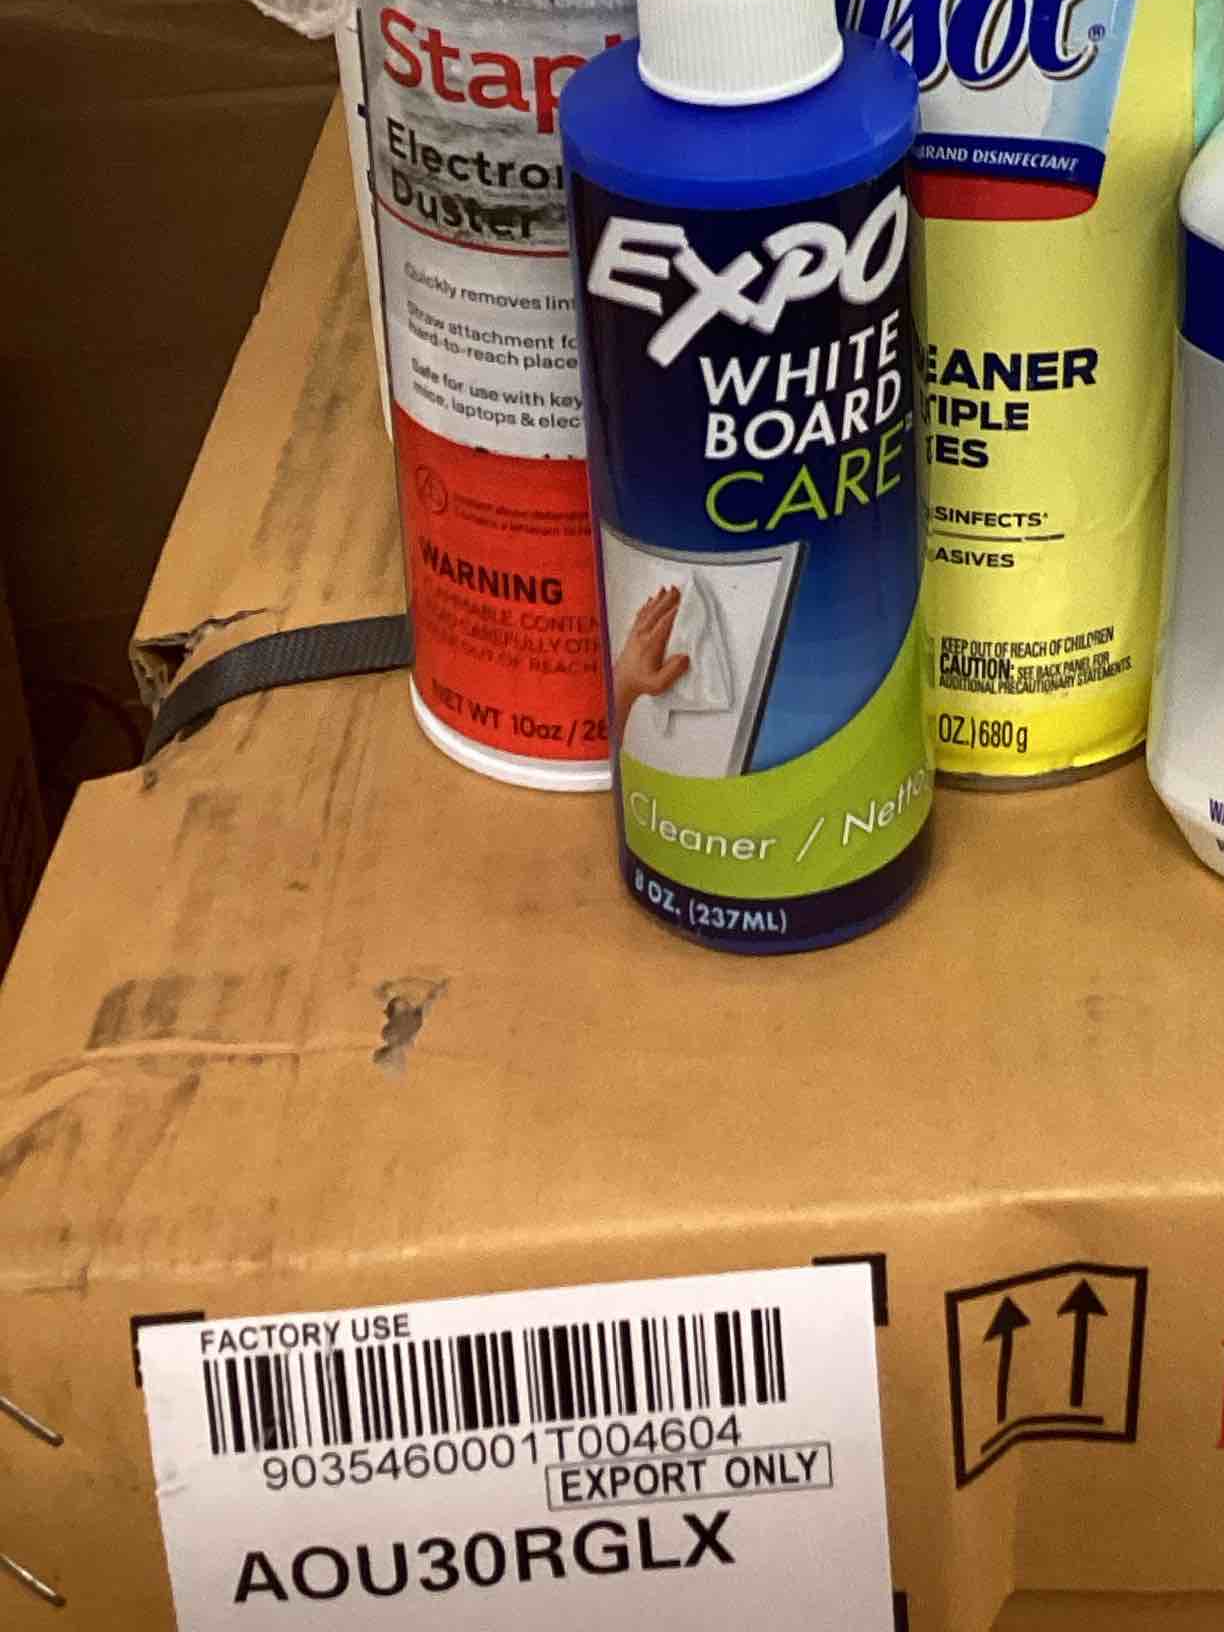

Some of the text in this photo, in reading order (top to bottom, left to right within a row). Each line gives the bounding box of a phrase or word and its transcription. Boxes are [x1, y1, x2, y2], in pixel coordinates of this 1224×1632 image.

[379, 6, 622, 135] Stap
[972, 148, 1080, 172] DISINFECTANT
[391, 169, 534, 240] Duster
[404, 260, 458, 300] Quickly
[460, 288, 541, 312] removes
[586, 183, 909, 369] EXPO
[448, 323, 555, 351] attachment
[561, 333, 577, 350] fo
[699, 308, 900, 407] WHITE
[411, 357, 440, 385] Safe
[444, 372, 465, 392] for
[469, 383, 498, 402] use
[502, 388, 546, 406] with
[451, 397, 517, 427] laptops
[519, 413, 536, 428] &
[703, 369, 902, 460] BOARD
[704, 422, 905, 533] CARE
[417, 534, 564, 606] WARNING
[939, 652, 1015, 681] CAUTION:
[1092, 651, 1111, 669] FOR
[940, 625, 1115, 659] KEEP OUT OF REACH OF CHILDREN
[998, 671, 1075, 696] PRECAUTIONARY
[468, 698, 504, 730] WT
[511, 712, 564, 742] 10oz
[627, 790, 777, 862] Cleaner
[632, 869, 789, 936] 8 OZ. (237ML)
[199, 1313, 411, 1355] FACTORY USE
[262, 1412, 743, 1493] 9035460001T004604
[559, 1449, 820, 1506] EXPORT ONLY
[232, 1509, 738, 1607] AOU30RGLX
